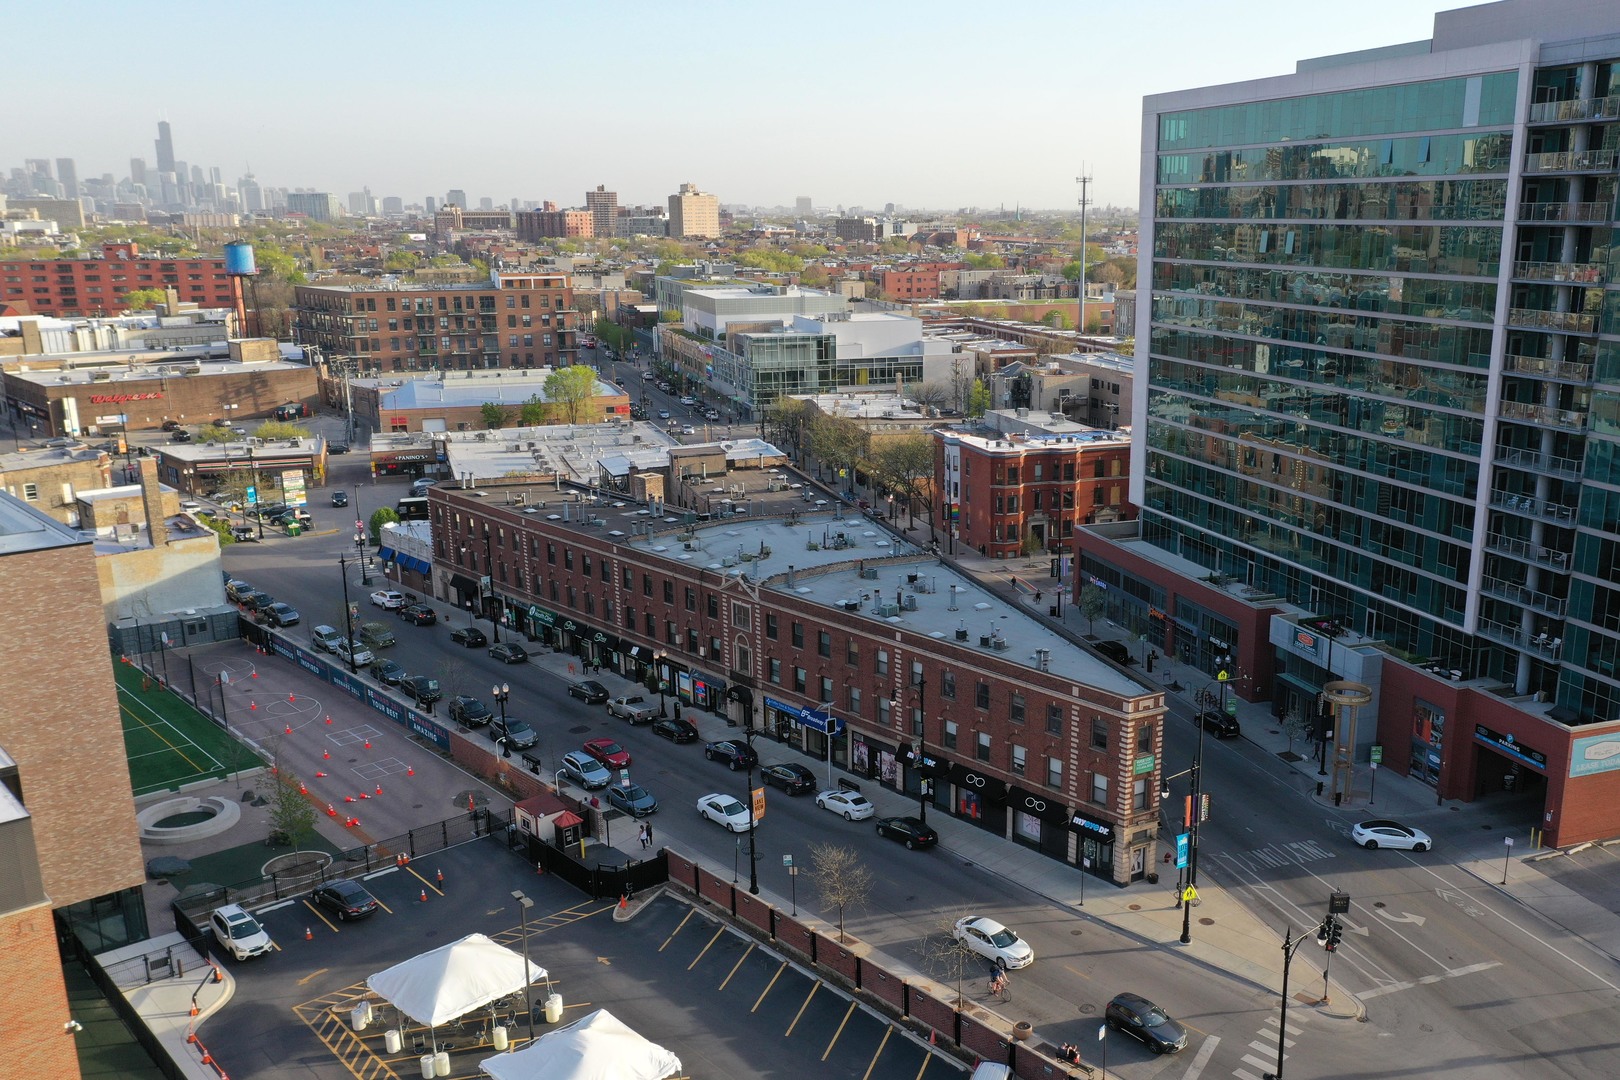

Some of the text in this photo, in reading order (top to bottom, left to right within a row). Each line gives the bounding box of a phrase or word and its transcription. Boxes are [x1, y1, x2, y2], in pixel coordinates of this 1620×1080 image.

[90, 392, 164, 404] Walgreens
[300, 658, 320, 674] INSPIRED
[371, 699, 399, 720] YOUR BEST
[408, 712, 447, 739] BERNARD ZELL
[413, 723, 438, 742] AMAZING
[1499, 739, 1520, 752] PARKING
